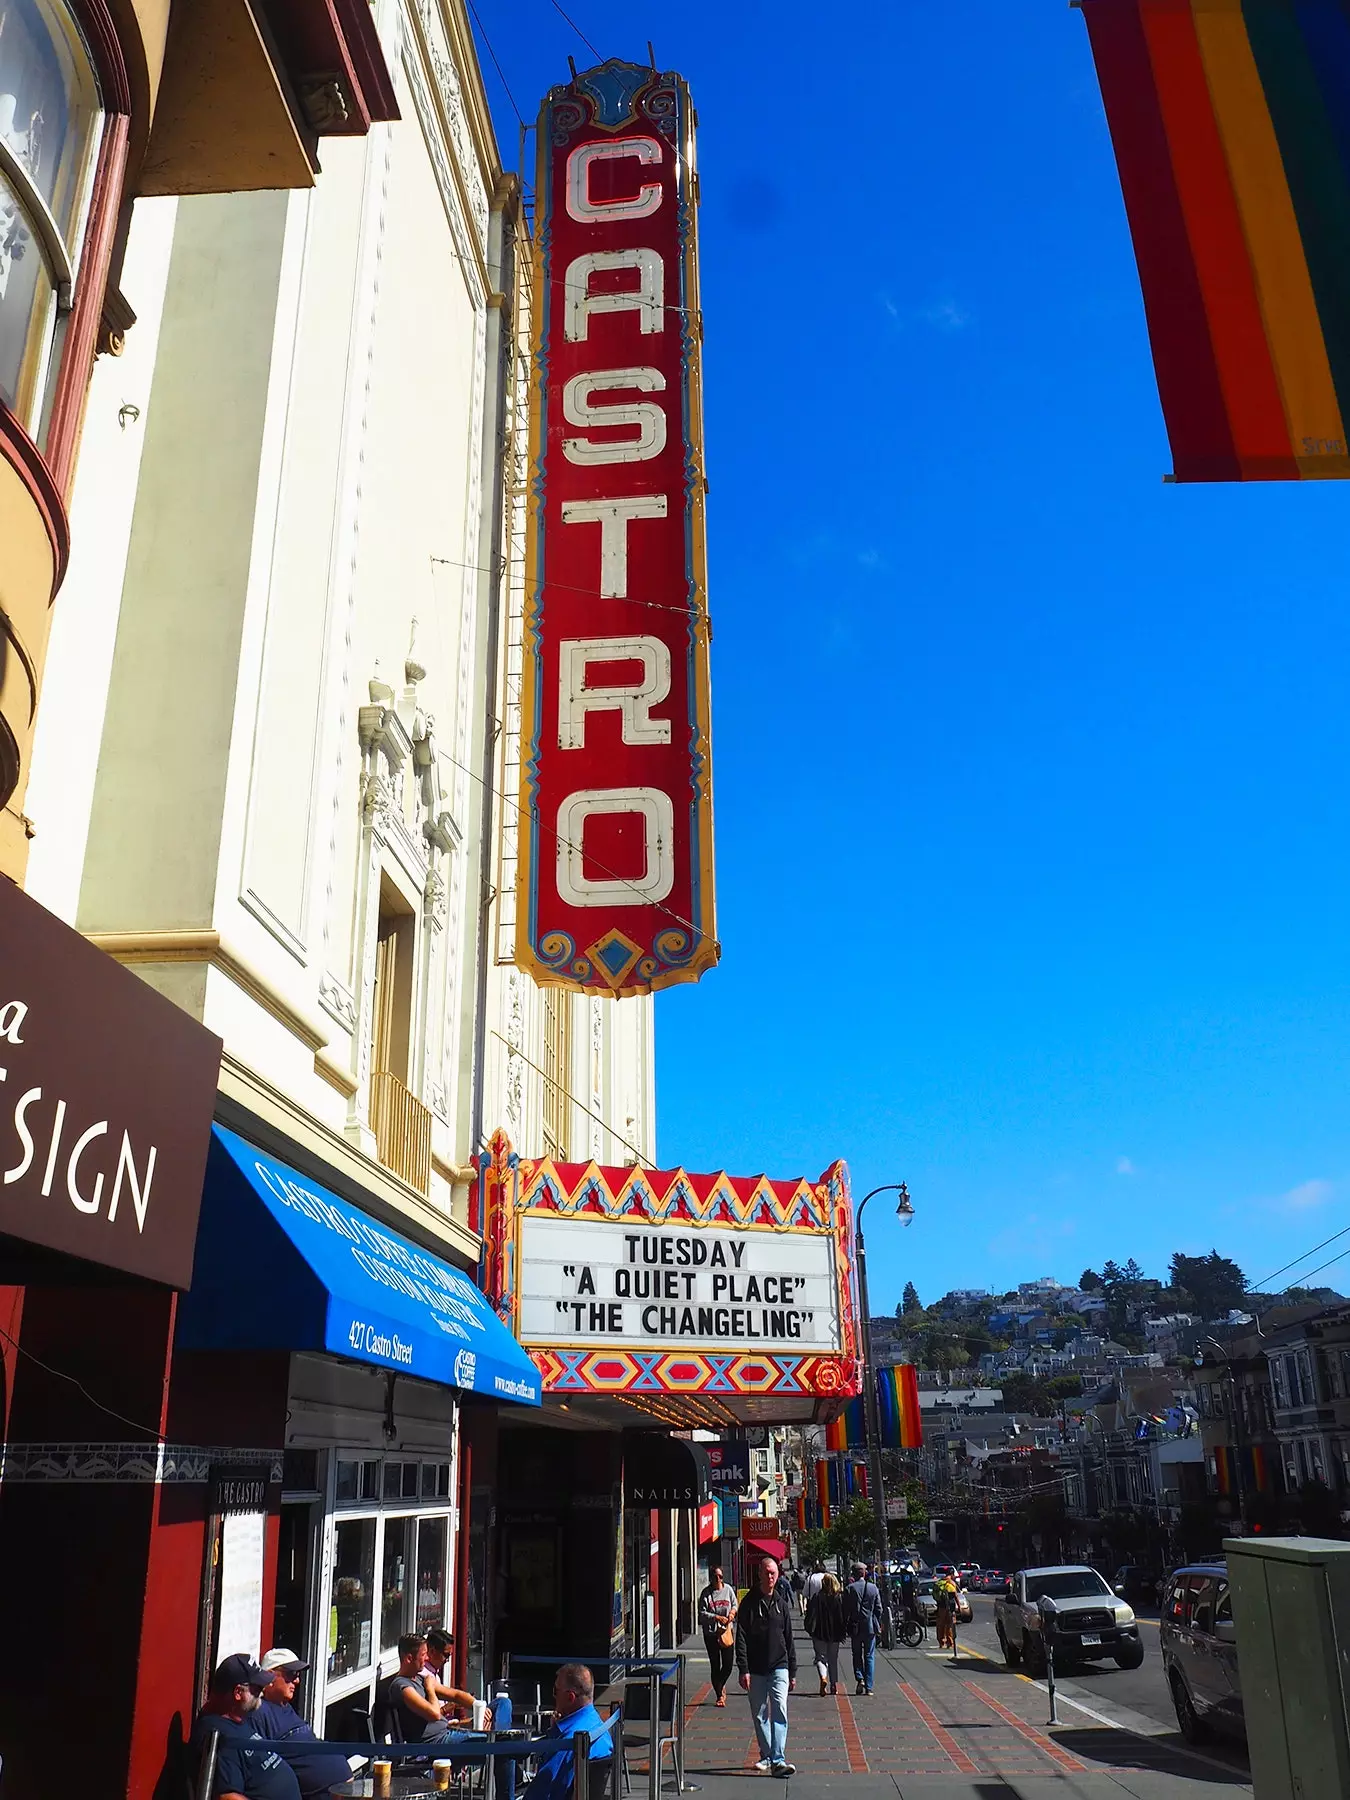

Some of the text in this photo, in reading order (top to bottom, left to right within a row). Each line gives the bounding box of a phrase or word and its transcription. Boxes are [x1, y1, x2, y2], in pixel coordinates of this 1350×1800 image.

[555, 134, 673, 909] CASTRO
[0, 1066, 157, 1234] SIGN
[255, 1161, 360, 1244] CASTRO
[350, 1217, 427, 1280] COFFEE
[625, 1235, 746, 1268] TUESDAY
[351, 1247, 429, 1305] CUSTOM
[615, 1269, 696, 1300] QUIET
[712, 1274, 806, 1304] PLACE"
[642, 1305, 814, 1338] CHANGELING"
[348, 1319, 413, 1365] 427 Castro Street
[218, 1481, 265, 1504] THE CASTRO
[633, 1487, 693, 1500] NAILS
[749, 1521, 774, 1531] SLURP
